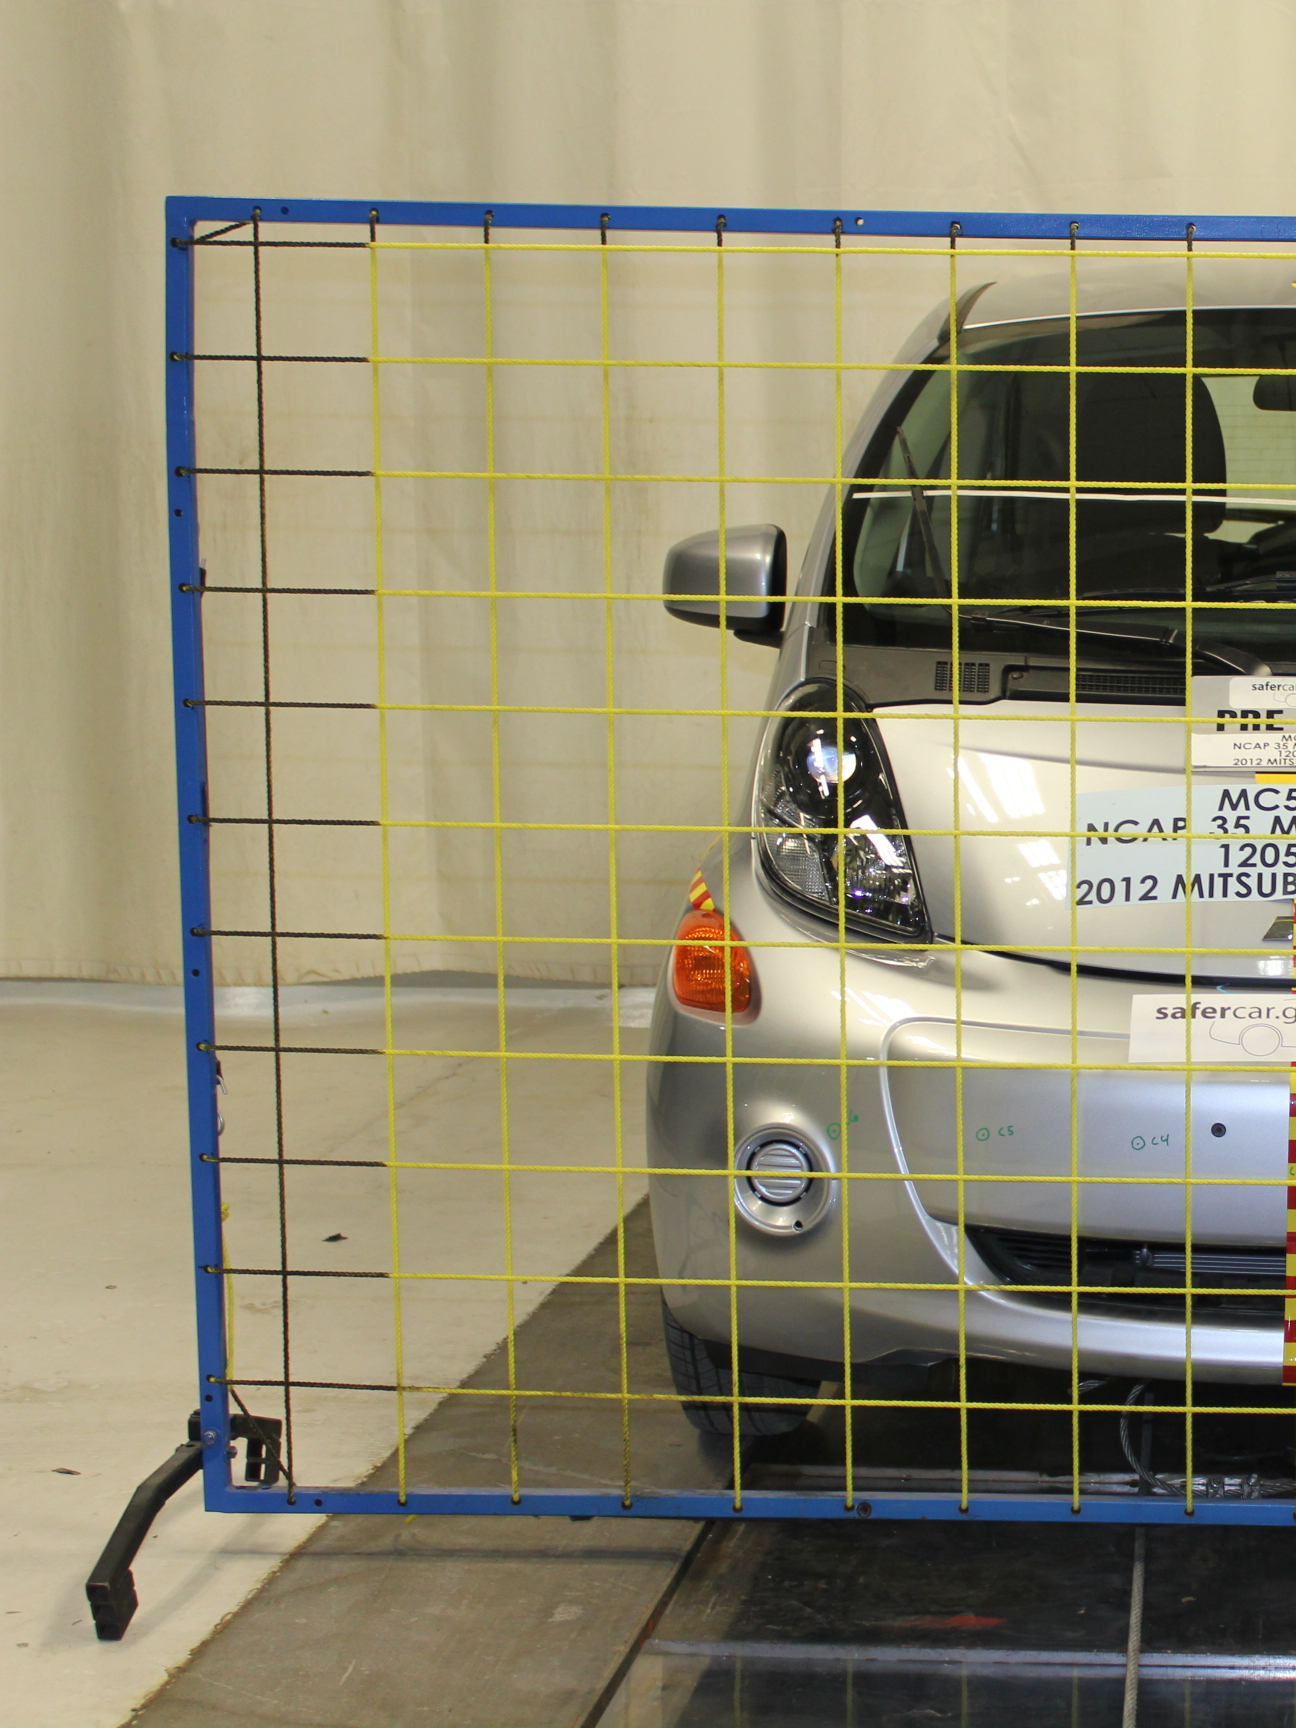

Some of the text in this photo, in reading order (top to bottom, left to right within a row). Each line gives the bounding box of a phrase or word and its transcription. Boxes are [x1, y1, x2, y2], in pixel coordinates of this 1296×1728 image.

[1216, 709, 1285, 732] PRE
[1232, 742, 1270, 750] NCAP
[1273, 742, 1289, 750] 35
[1232, 758, 1263, 766] 2012
[1085, 817, 1188, 847] NCAP
[1208, 815, 1251, 839] 35
[1074, 875, 1159, 906] 2012
